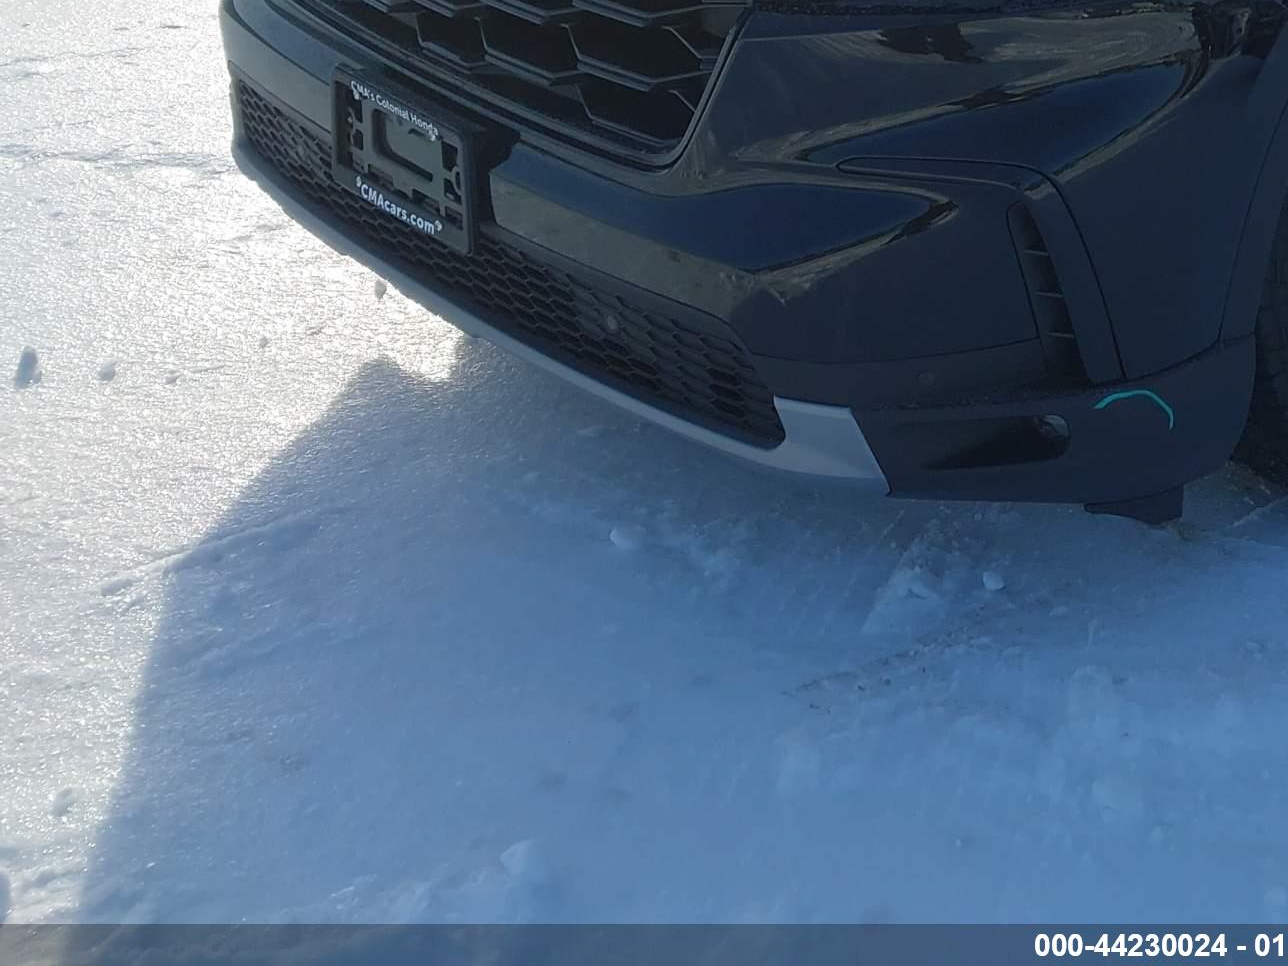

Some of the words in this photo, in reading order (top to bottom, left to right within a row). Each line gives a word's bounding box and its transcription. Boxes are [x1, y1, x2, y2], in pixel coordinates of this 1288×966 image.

[375, 94, 410, 121] Colonial
[410, 113, 438, 137] Honda
[360, 183, 435, 234] CMAcars.com
